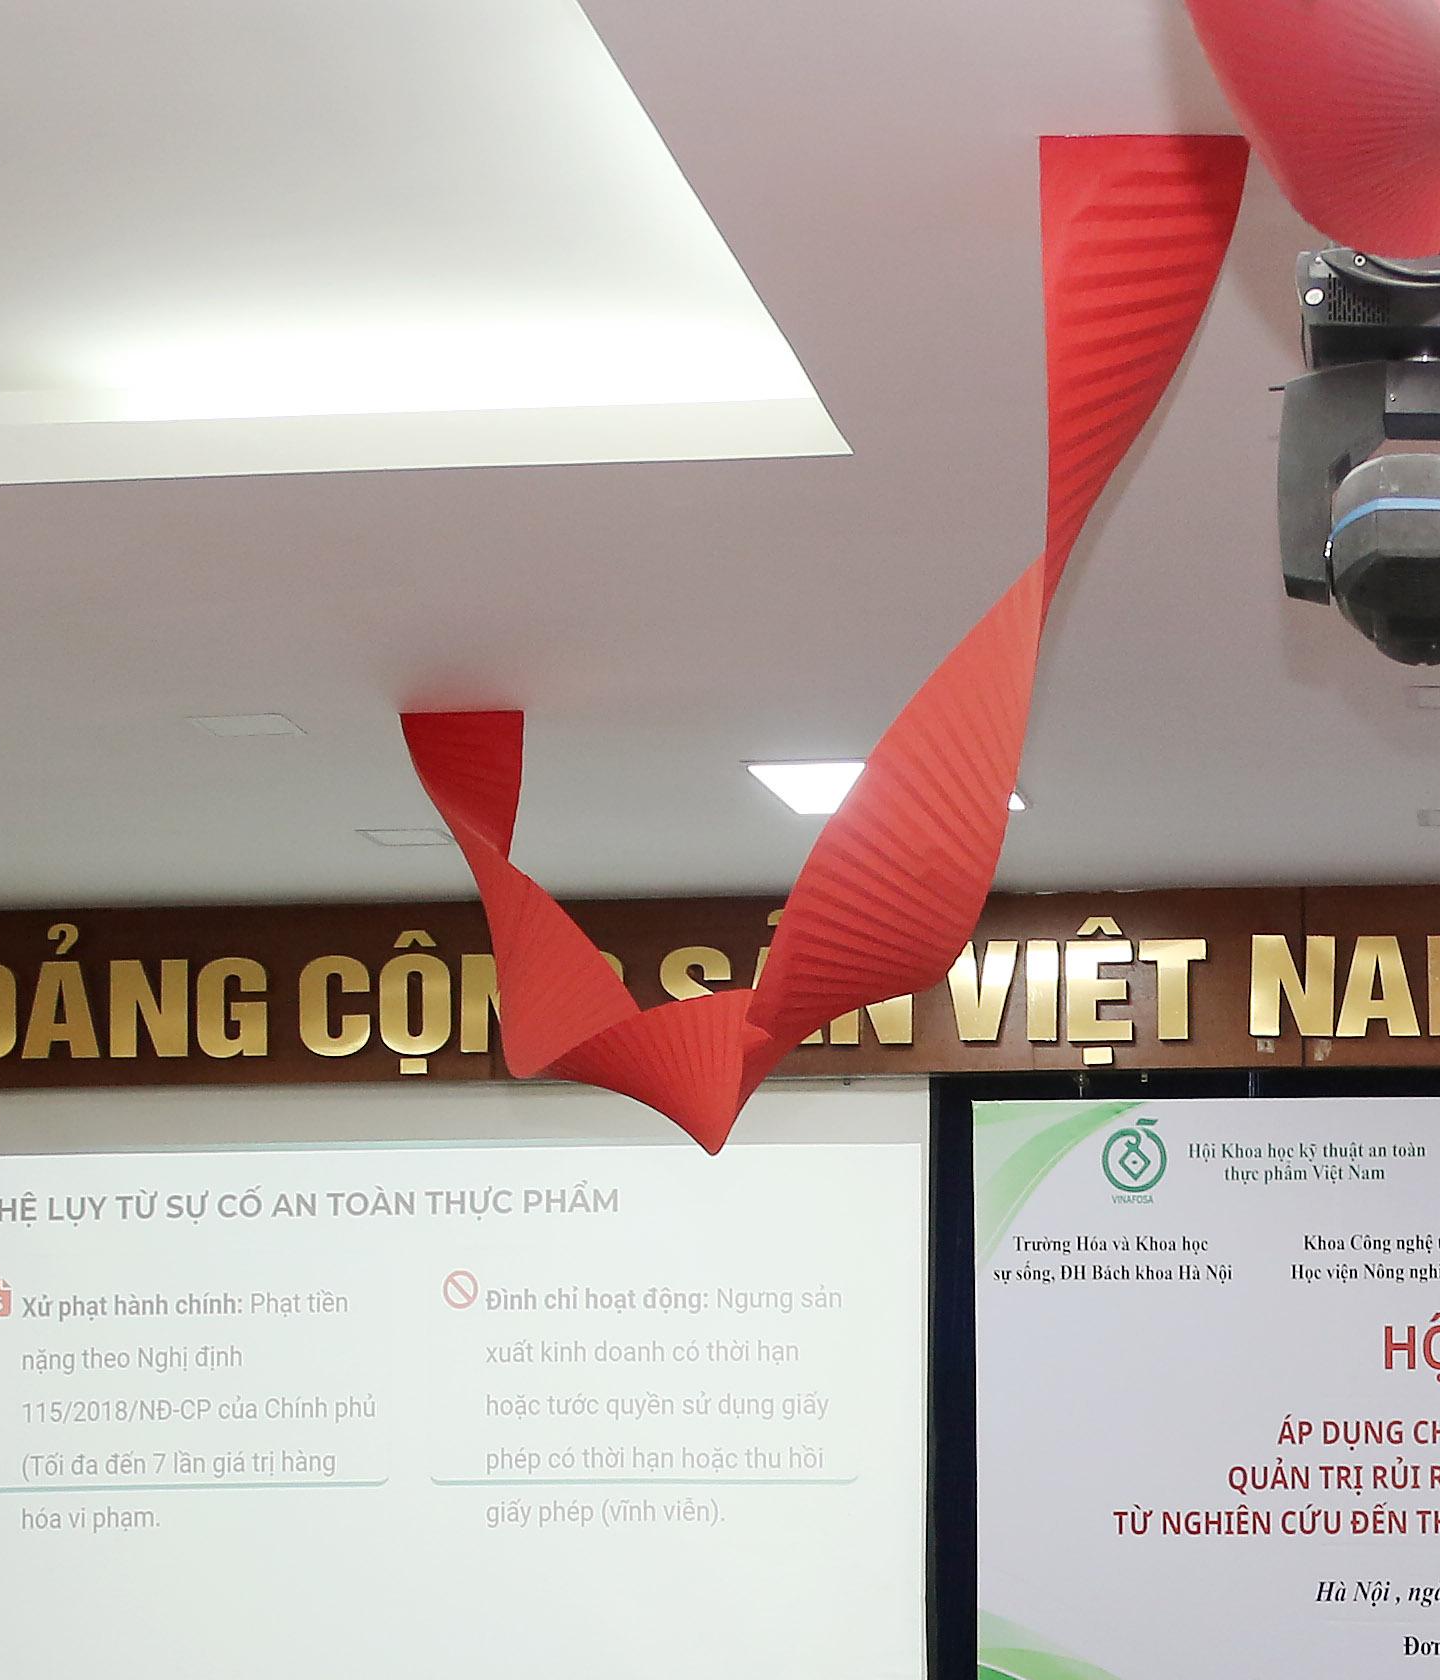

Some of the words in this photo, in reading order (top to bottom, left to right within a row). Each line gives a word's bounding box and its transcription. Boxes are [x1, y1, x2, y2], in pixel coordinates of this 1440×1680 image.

[946, 916, 1207, 1065] VIỆT
[1190, 1143, 1215, 1162] Hội
[1222, 1143, 1262, 1158] Khoa
[1268, 1143, 1294, 1163] học
[1300, 1143, 1316, 1162] kỹ
[1323, 1142, 1363, 1161] thuật
[1369, 1147, 1386, 1157] an
[1393, 1142, 1425, 1157] toàn
[1225, 1166, 1258, 1184] thực
[1265, 1161, 1307, 1184] phẩm
[1312, 1165, 1342, 1184] Việt
[1349, 1165, 1384, 1179] Nam
[49, 1196, 107, 1226] LỤY
[115, 1189, 158, 1219] TỪ
[166, 1190, 209, 1224] SỰ
[218, 1185, 262, 1218] CỐ
[271, 1193, 316, 1217] AN
[326, 1185, 414, 1216] TOÀN
[425, 1186, 512, 1220] THỰC
[524, 1180, 618, 1213] PHẨM
[1013, 1236, 1070, 1255] Trường
[1077, 1236, 1107, 1251] Hóa
[1112, 1236, 1129, 1251] và
[1136, 1236, 1176, 1251] Khoa
[1183, 1236, 1208, 1255] học
[993, 1266, 1012, 1284] sự
[1015, 1260, 1056, 1284] sống,
[1061, 1265, 1086, 1281] ĐH
[1093, 1265, 1129, 1280] Bách
[1136, 1265, 1172, 1280] khoa
[1180, 1265, 1200, 1280] Hà
[1207, 1265, 1231, 1284] Nội
[22, 1294, 54, 1318] Xử
[59, 1295, 107, 1322] phạt
[114, 1294, 168, 1315] hành
[176, 1292, 242, 1314] chính:
[251, 1292, 301, 1317] Phạt
[307, 1289, 347, 1313] tiền
[22, 1349, 75, 1375] nặng
[81, 1347, 130, 1369] theo
[138, 1346, 187, 1373] Nghị
[195, 1345, 242, 1371] định
[22, 1399, 211, 1424] 115/2018/NĐ-CP
[218, 1395, 257, 1419] của
[265, 1396, 327, 1419] Chính
[336, 1393, 375, 1424] phủ
[1278, 1414, 1312, 1444] ÁP
[1323, 1421, 1403, 1451] DỤNG
[22, 1452, 64, 1481] (Tối
[71, 1454, 98, 1475] đa
[105, 1451, 145, 1474] đến
[153, 1453, 166, 1474] 7
[174, 1450, 205, 1474] lần
[213, 1451, 245, 1478] giá
[251, 1451, 274, 1476] trị
[282, 1450, 335, 1477] hàng
[1229, 1457, 1309, 1495] QUẢN
[1319, 1466, 1363, 1496] TRỊ
[1373, 1457, 1420, 1489] RỦI
[22, 1507, 61, 1530] hóa
[68, 1507, 85, 1528] vi
[93, 1506, 160, 1534] phạm.
[1113, 1504, 1153, 1535] TỪ
[1163, 1504, 1270, 1535] NGHIÊN
[1282, 1504, 1340, 1534] CỨU
[1351, 1502, 1406, 1534] ĐẾN
[1316, 1581, 1346, 1601] Hà
[1353, 1581, 1390, 1607] Nội
